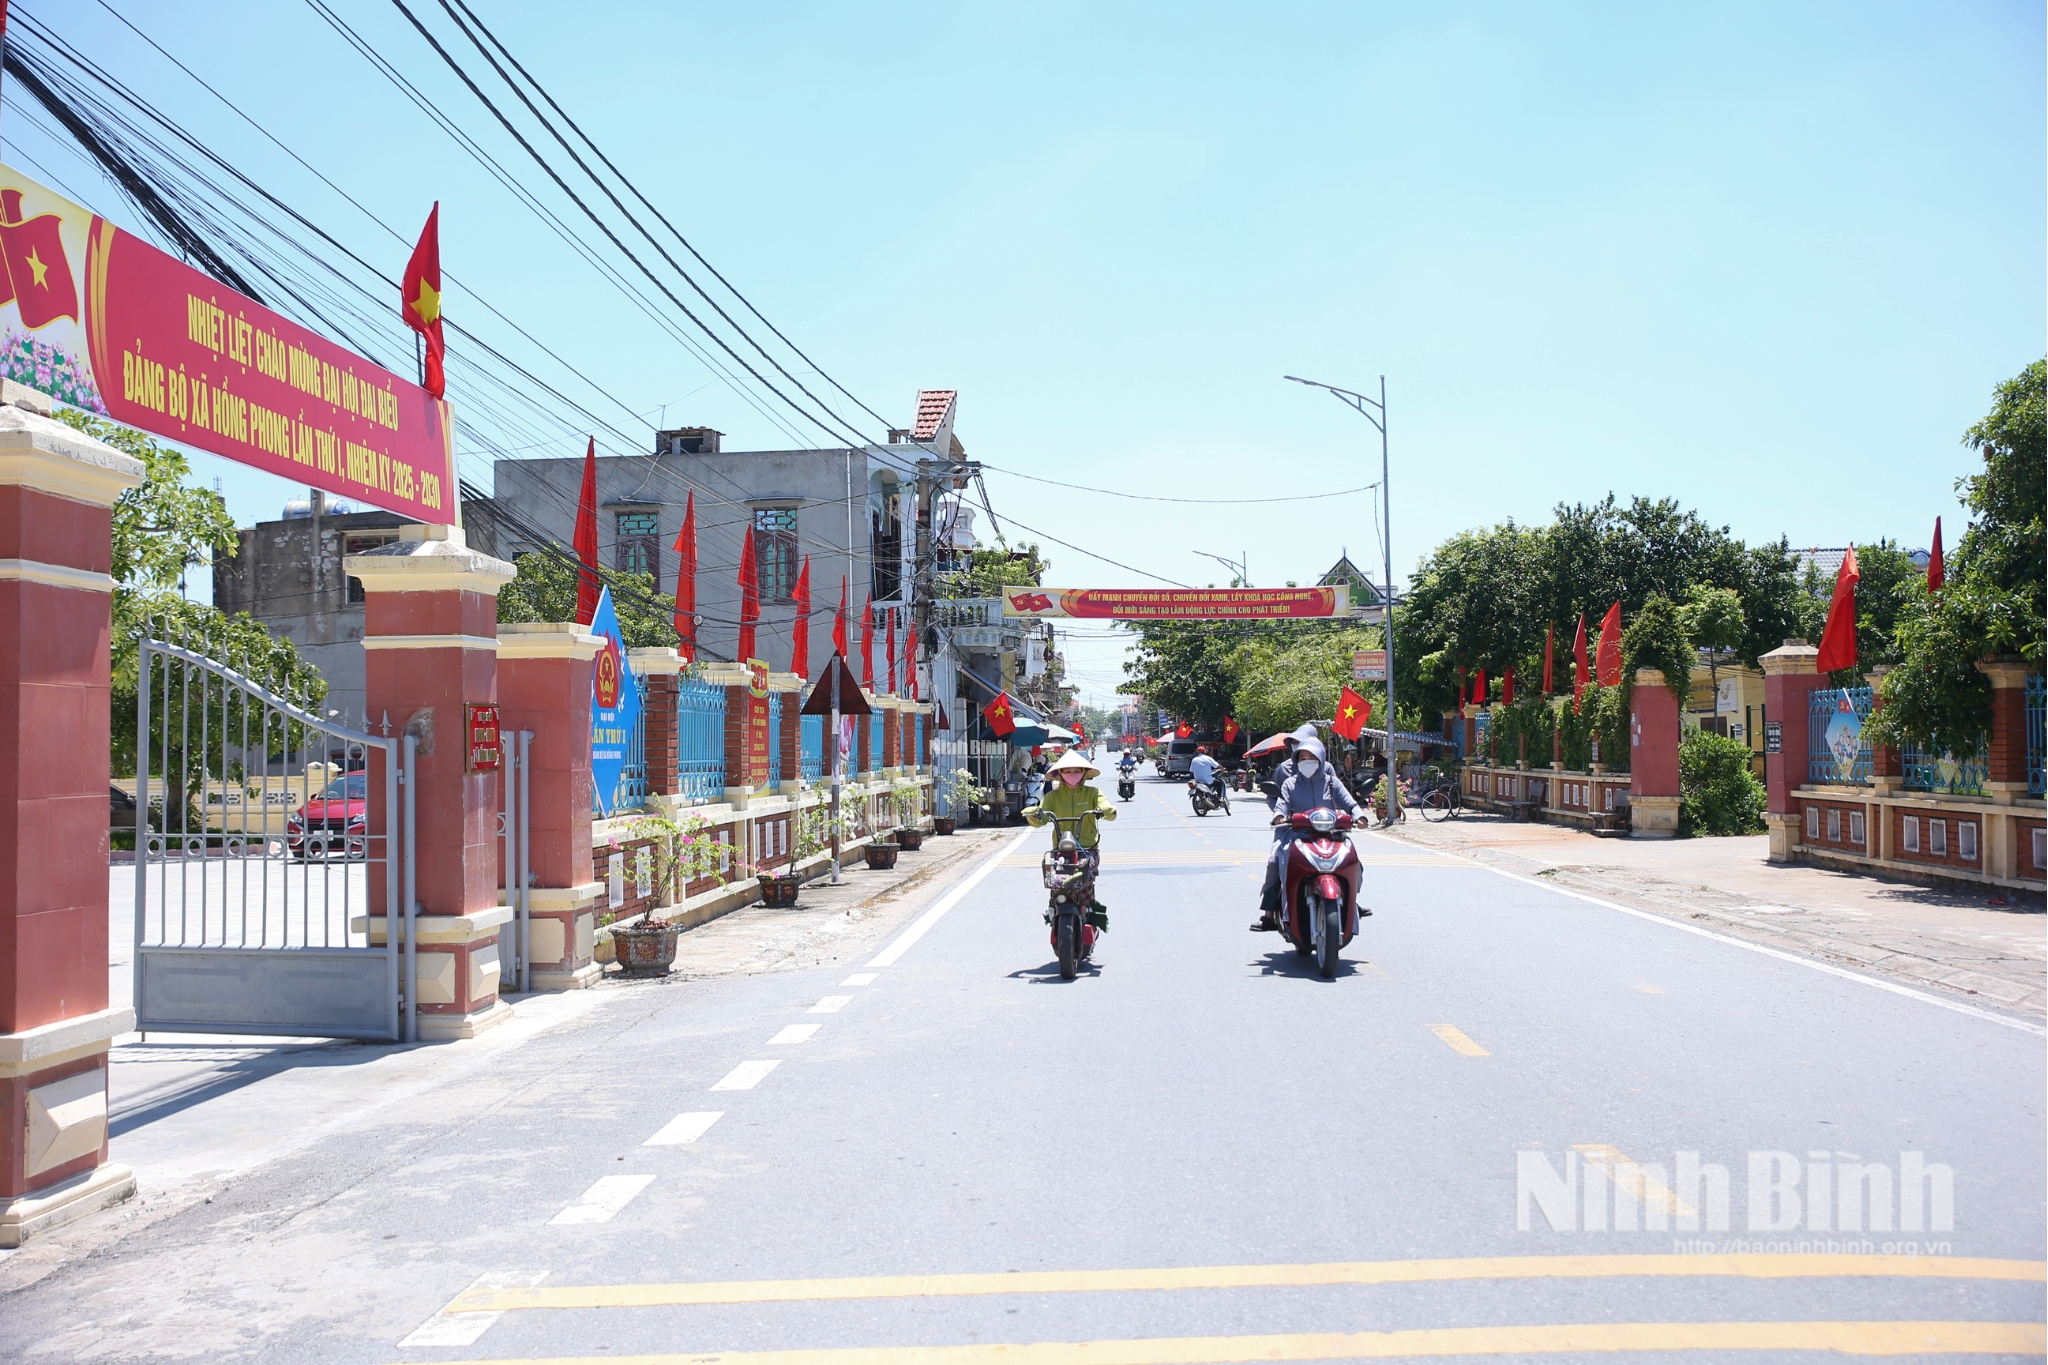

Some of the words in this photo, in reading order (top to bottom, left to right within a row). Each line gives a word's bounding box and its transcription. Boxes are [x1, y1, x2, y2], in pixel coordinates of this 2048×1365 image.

[187, 293, 225, 362] NHIỆT
[228, 310, 253, 374] LIỆT
[256, 326, 286, 383] CHÀO
[289, 341, 322, 398] MỪNG
[322, 361, 340, 414] ĐẠI
[342, 366, 360, 422] HỘI
[360, 379, 376, 429] ĐẠI
[378, 378, 399, 432] BIỂU
[124, 338, 165, 414] ĐẢNG
[169, 363, 188, 432] BỘ
[191, 373, 210, 430] XÃ
[212, 376, 248, 444] HỒNG
[250, 402, 290, 459] PHONG
[292, 408, 314, 468] LẦN
[315, 426, 336, 474] THỨ
[337, 437, 345, 483] I,
[346, 439, 378, 494] NHIỆM
[378, 448, 390, 494] KỲ
[392, 459, 414, 502] 2025
[420, 470, 441, 510] 2030
[1088, 590, 1101, 602] ĐẨY
[1102, 593, 1122, 603] MẠNH
[1122, 590, 1148, 602] CHUYỂN
[1148, 590, 1160, 602] ĐỔI
[1161, 590, 1172, 602] SỐ,
[1173, 590, 1198, 602] CHUYỂN
[1199, 590, 1210, 602] ĐỔI
[1211, 593, 1230, 602] XANH,
[1231, 590, 1243, 602] LẤY
[1244, 593, 1260, 602] KHOA
[1262, 593, 1275, 603] HỌC
[1276, 592, 1294, 601] CÔNG
[1294, 591, 1314, 602] NGHỆ,
[1112, 604, 1123, 614] ĐỔI
[1124, 605, 1138, 614] MỚI
[1138, 605, 1156, 614] SÁNG
[1157, 606, 1170, 616] TẠO
[1170, 605, 1184, 614] LÀM
[1186, 604, 1203, 616] ĐỘNG
[1204, 606, 1216, 616] LỰC
[1218, 605, 1237, 614] CHÍNH
[1238, 606, 1251, 614] CHO
[1252, 604, 1268, 614] PHÁT
[1270, 602, 1290, 614] TRIỂN!
[592, 722, 604, 744] ẦN
[606, 726, 621, 744] THỨ
[622, 729, 626, 744] I
